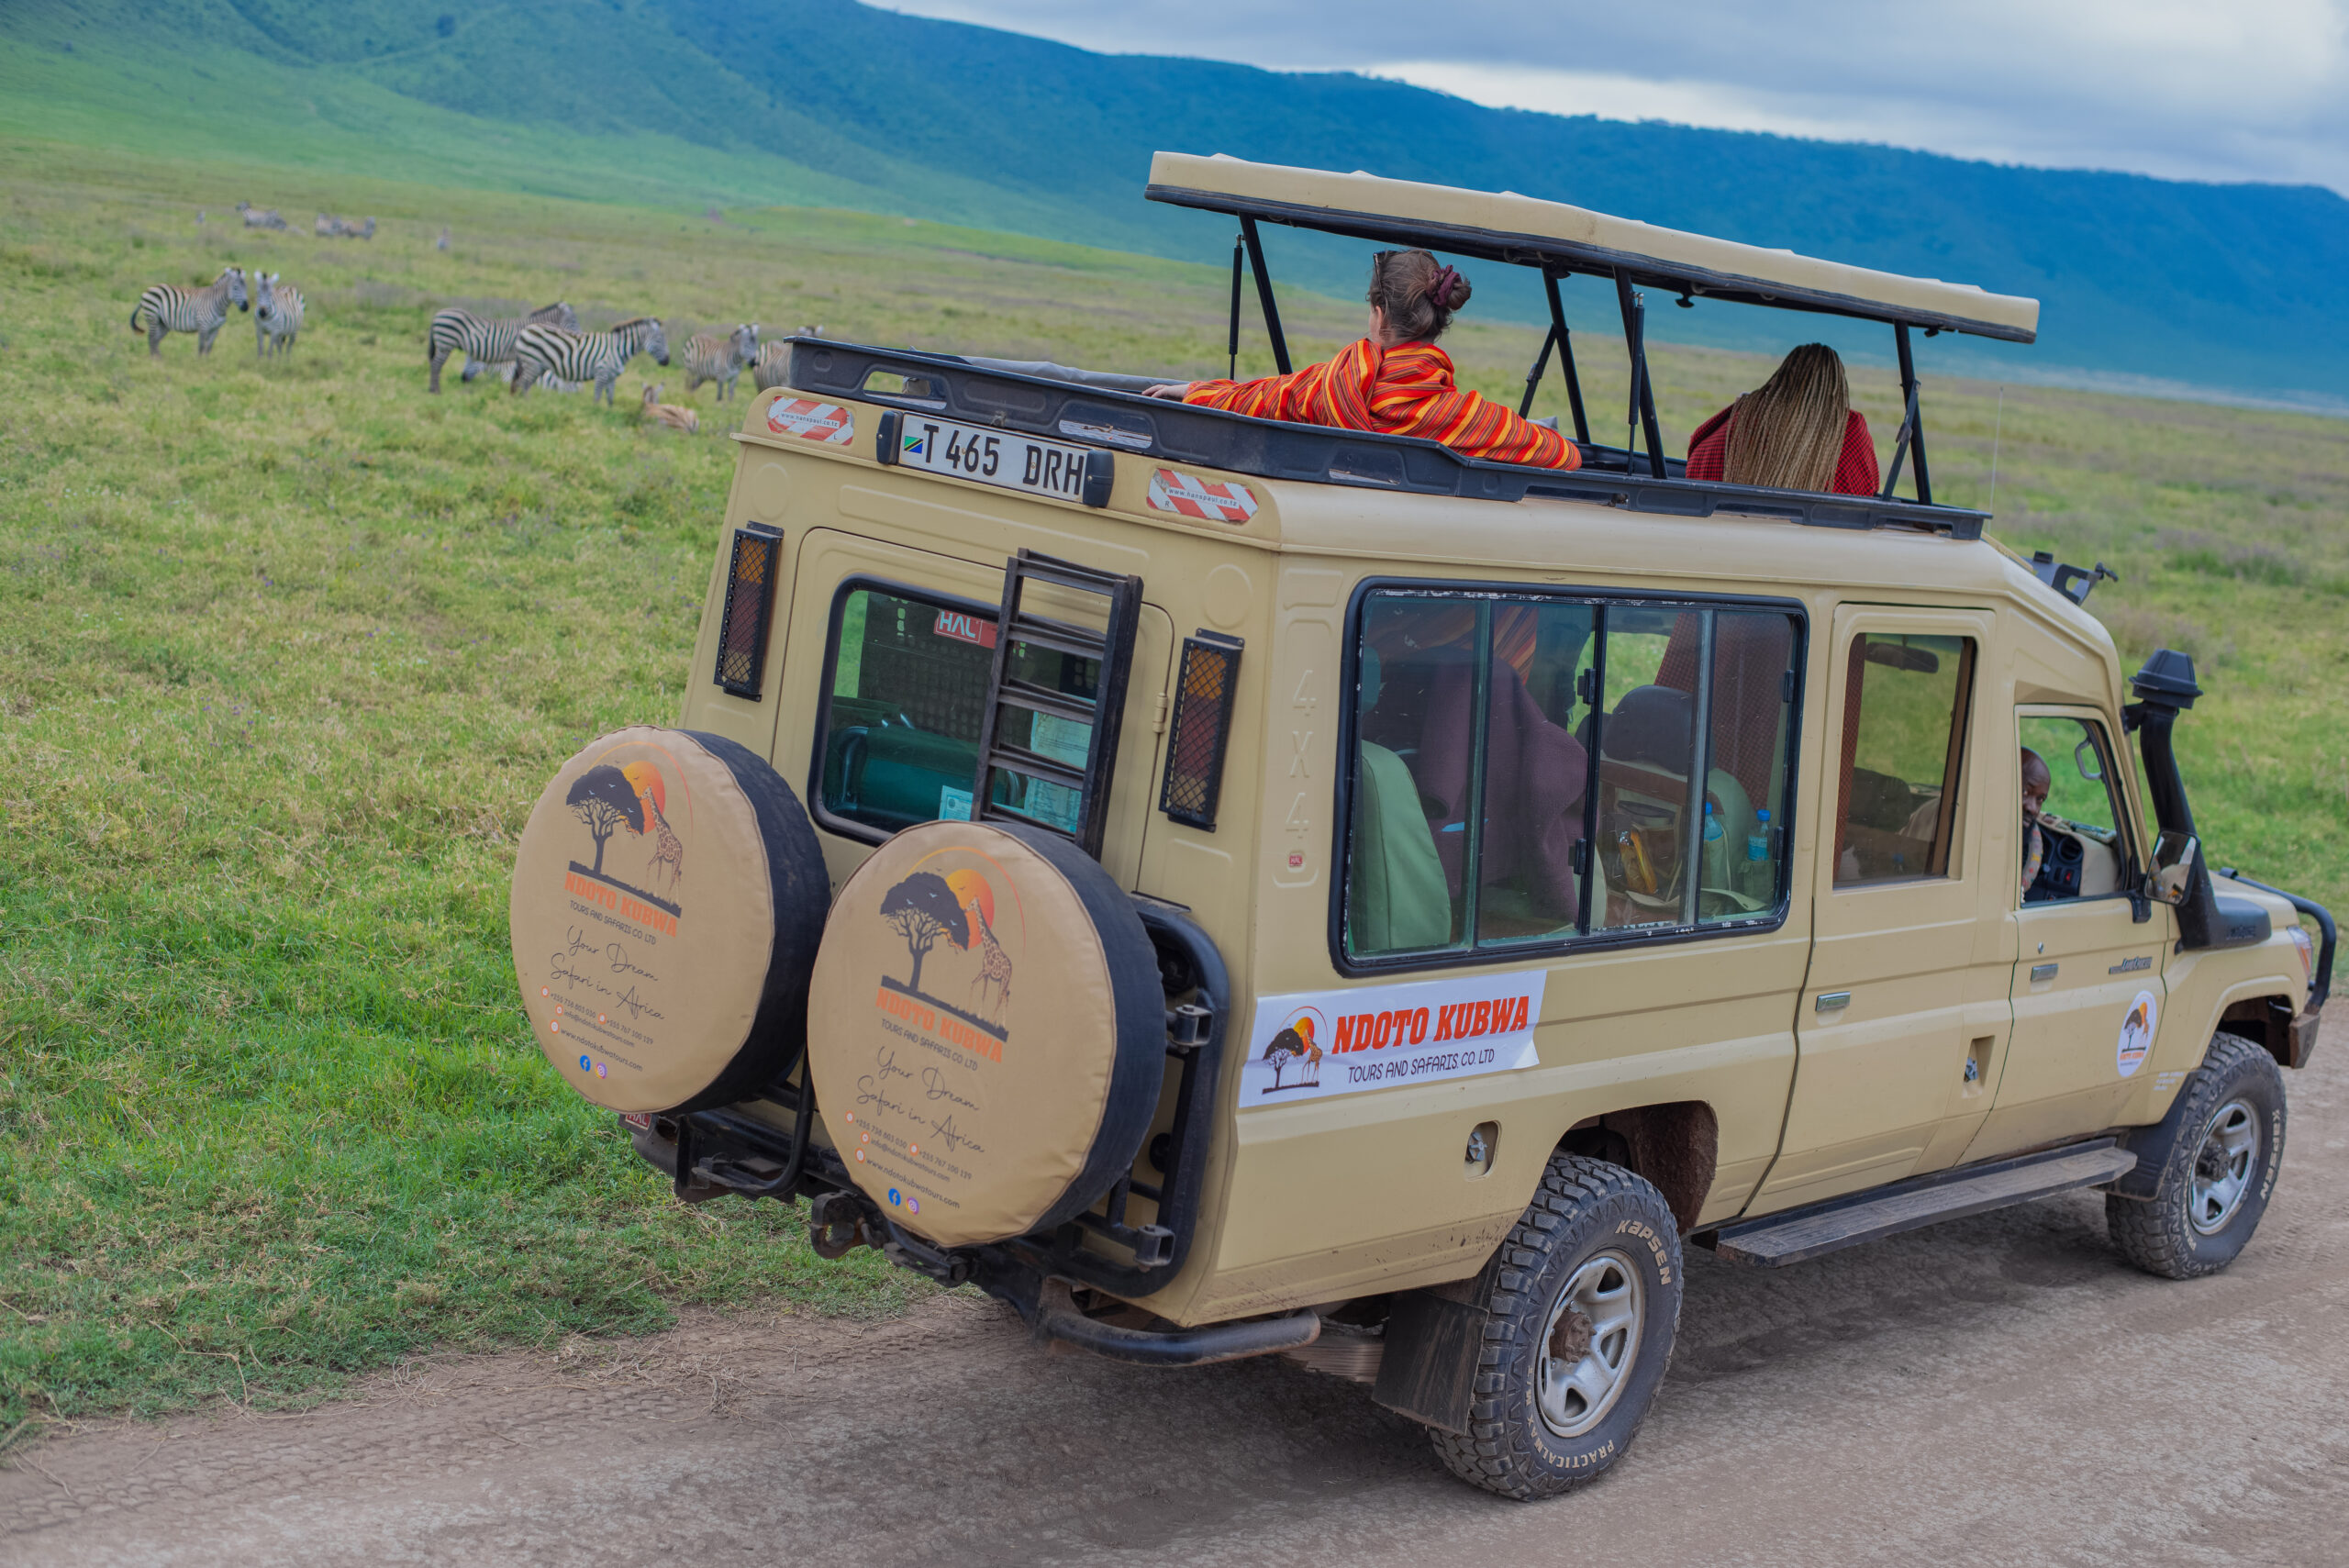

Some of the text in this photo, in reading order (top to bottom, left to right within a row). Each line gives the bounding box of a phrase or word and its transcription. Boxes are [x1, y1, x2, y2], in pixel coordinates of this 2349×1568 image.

[781, 412, 838, 427] www.hanspaul.co.tz
[924, 423, 1085, 495] T 465 DRH
[1168, 488, 1238, 506] www.hanspaul.co.tz
[939, 610, 975, 639] HAL
[564, 872, 677, 938] NDOTO KUBWA
[570, 900, 589, 916] TOURS
[589, 910, 603, 921] AND
[604, 916, 631, 934] SAFARIS
[644, 934, 656, 945] LTD
[567, 925, 659, 982] Your Dream
[551, 952, 665, 1019] Safari in Africa
[561, 1029, 643, 1072] www.ndotokubwatours.com
[875, 986, 1003, 1063] NDOTO KUBWA
[882, 1018, 903, 1036] TOURS
[903, 1029, 918, 1043] AND
[919, 1036, 952, 1059] SAFARIS
[964, 1058, 978, 1071] LTD
[1331, 995, 1530, 1055] NDOTO KUBWA
[877, 1046, 980, 1110] Your Dream
[1349, 1062, 1383, 1084] TOURS
[1386, 1060, 1408, 1078] AND
[1478, 1049, 1495, 1064] LTD
[856, 1074, 985, 1152] Safari in Africa
[866, 1158, 960, 1208] www.ndotokubwatours.com
